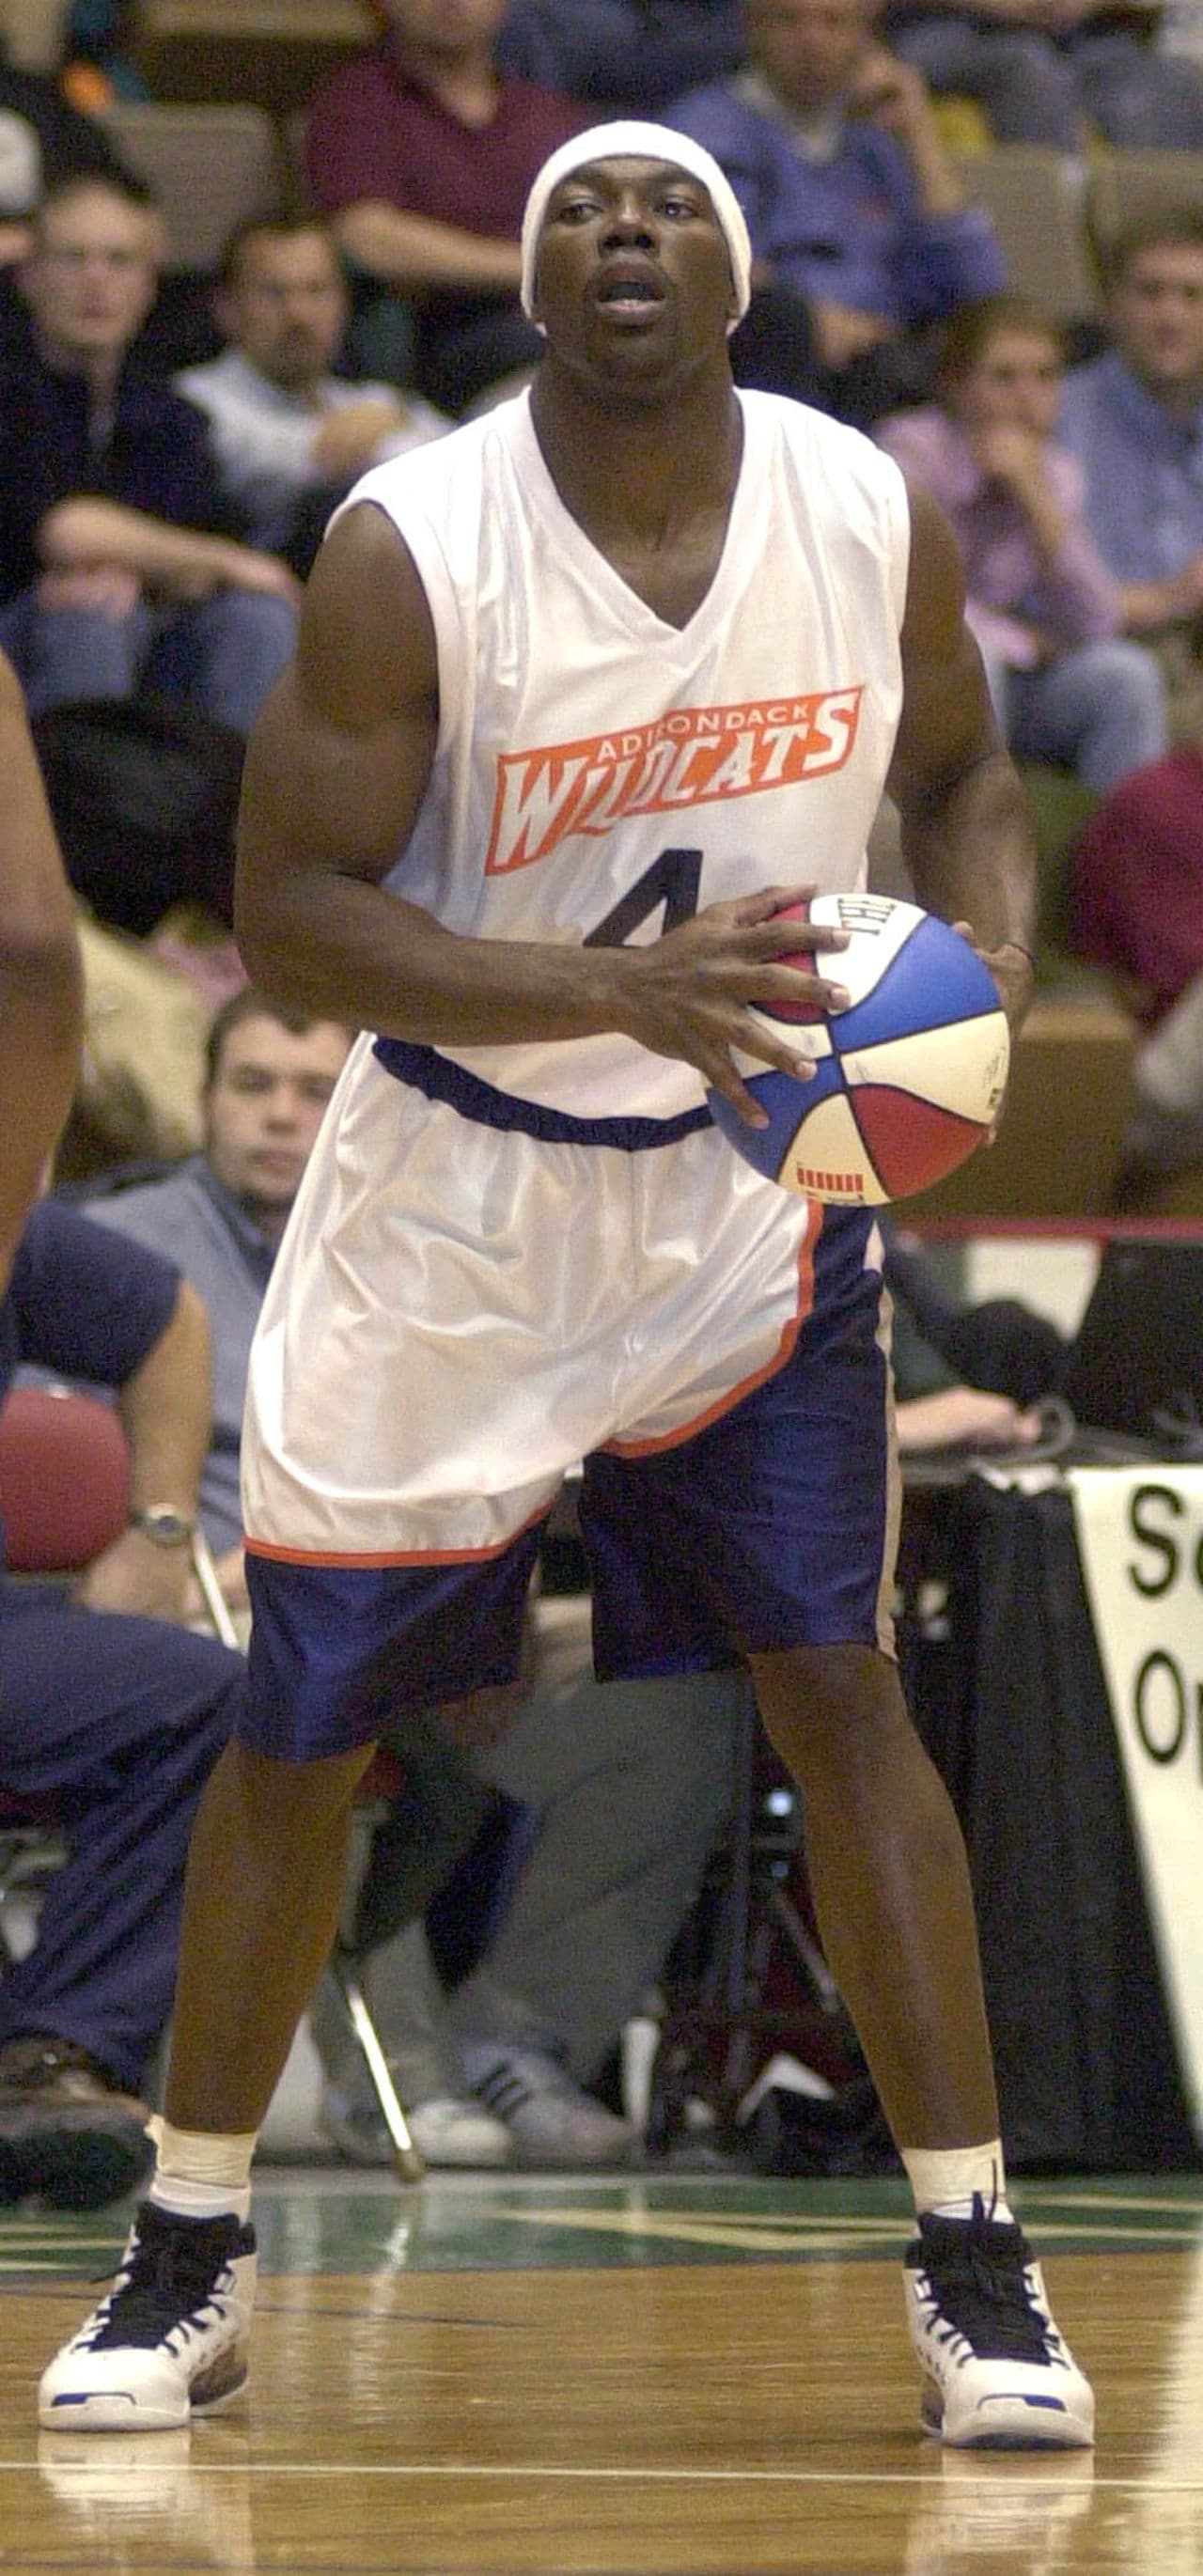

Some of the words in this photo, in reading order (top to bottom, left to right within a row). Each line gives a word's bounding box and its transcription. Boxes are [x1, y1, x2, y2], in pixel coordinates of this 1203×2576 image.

[492, 691, 856, 866] WILDCATS
[596, 704, 809, 763] ADIONDACK
[1128, 1483, 1203, 1598] S
[1134, 1647, 1203, 1791] O
